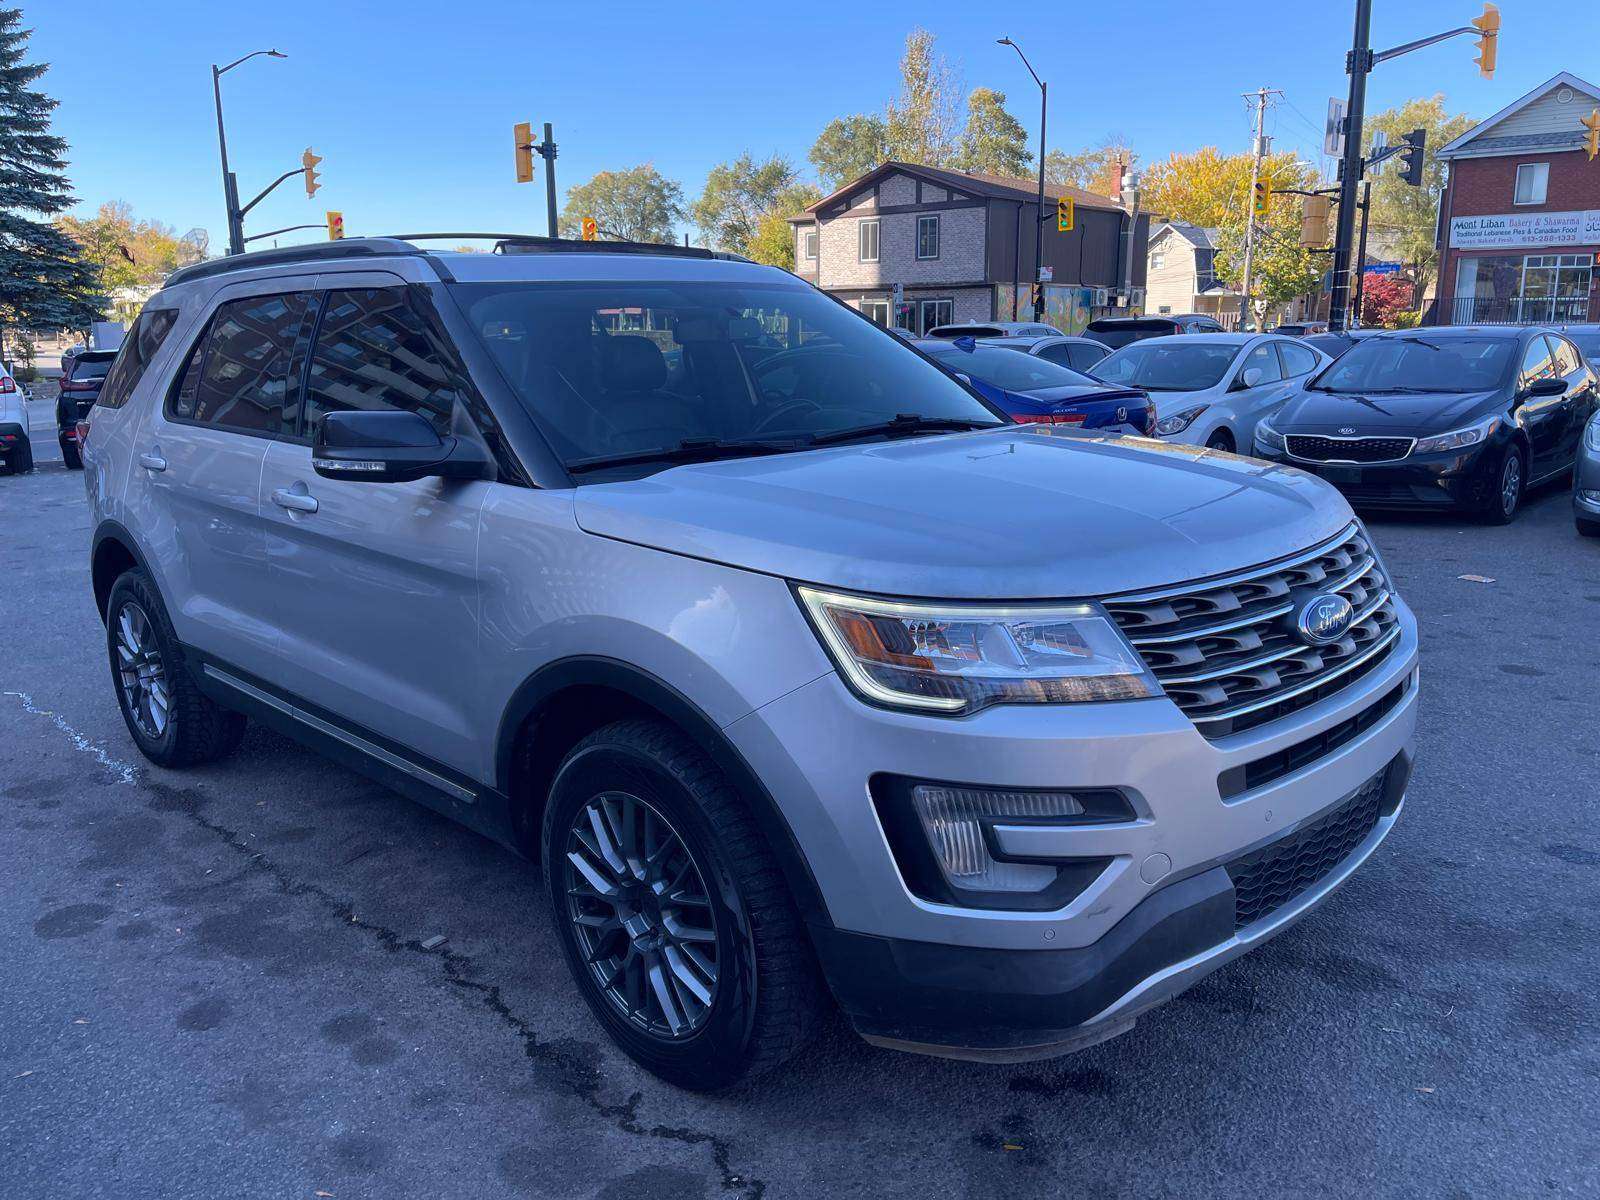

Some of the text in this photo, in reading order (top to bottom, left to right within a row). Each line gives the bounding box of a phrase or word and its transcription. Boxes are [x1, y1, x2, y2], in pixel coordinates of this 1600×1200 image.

[1454, 221, 1477, 230] Mont
[1480, 219, 1505, 229] Liban
[1509, 218, 1532, 228] Bakery
[1535, 217, 1541, 226] &
[1543, 216, 1580, 226] Shawarma
[1562, 226, 1578, 234] Food
[1317, 602, 1351, 631] Ford
